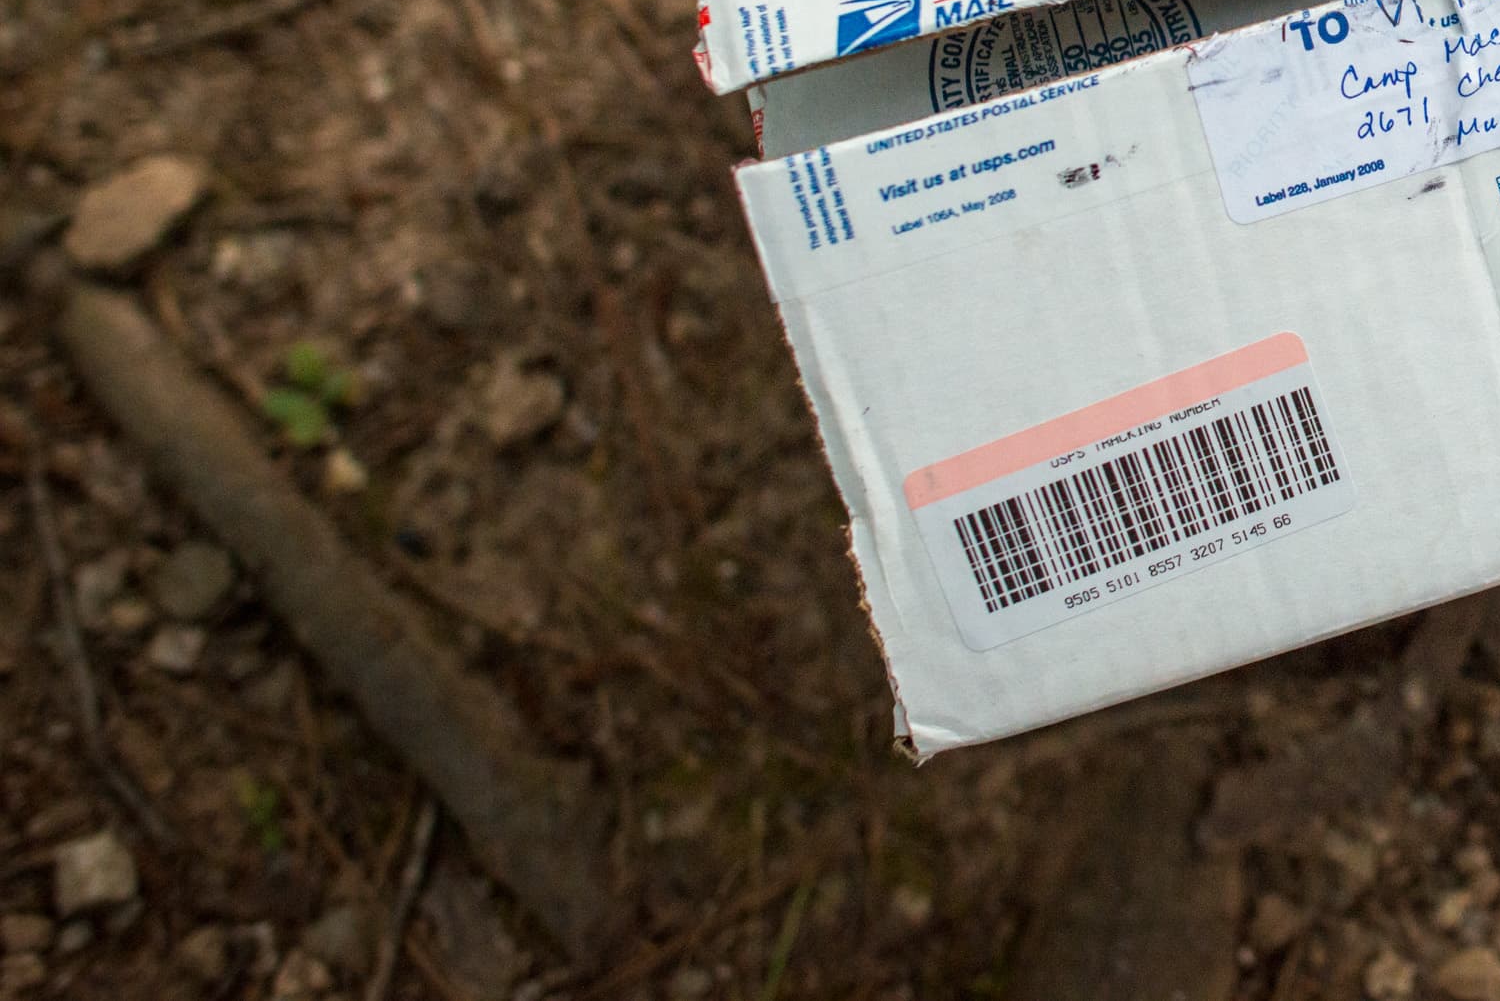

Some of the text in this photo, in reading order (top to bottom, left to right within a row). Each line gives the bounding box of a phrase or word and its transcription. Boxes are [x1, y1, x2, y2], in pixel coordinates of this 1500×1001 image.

[1290, 11, 1350, 51] TO
[1340, 61, 1418, 99] Camp
[867, 74, 1099, 156] UNITED STATES POSTAL SERVICE
[1357, 97, 1430, 138] 2671
[880, 137, 1056, 202] Visit us at usps.com
[1256, 188, 1287, 207] Label
[1313, 168, 1356, 192] January
[1357, 159, 1385, 177] 2008
[892, 188, 1017, 236] Label 106A, May 2008
[1063, 513, 1293, 609] 9505 5101 8557 3207 5145 66
